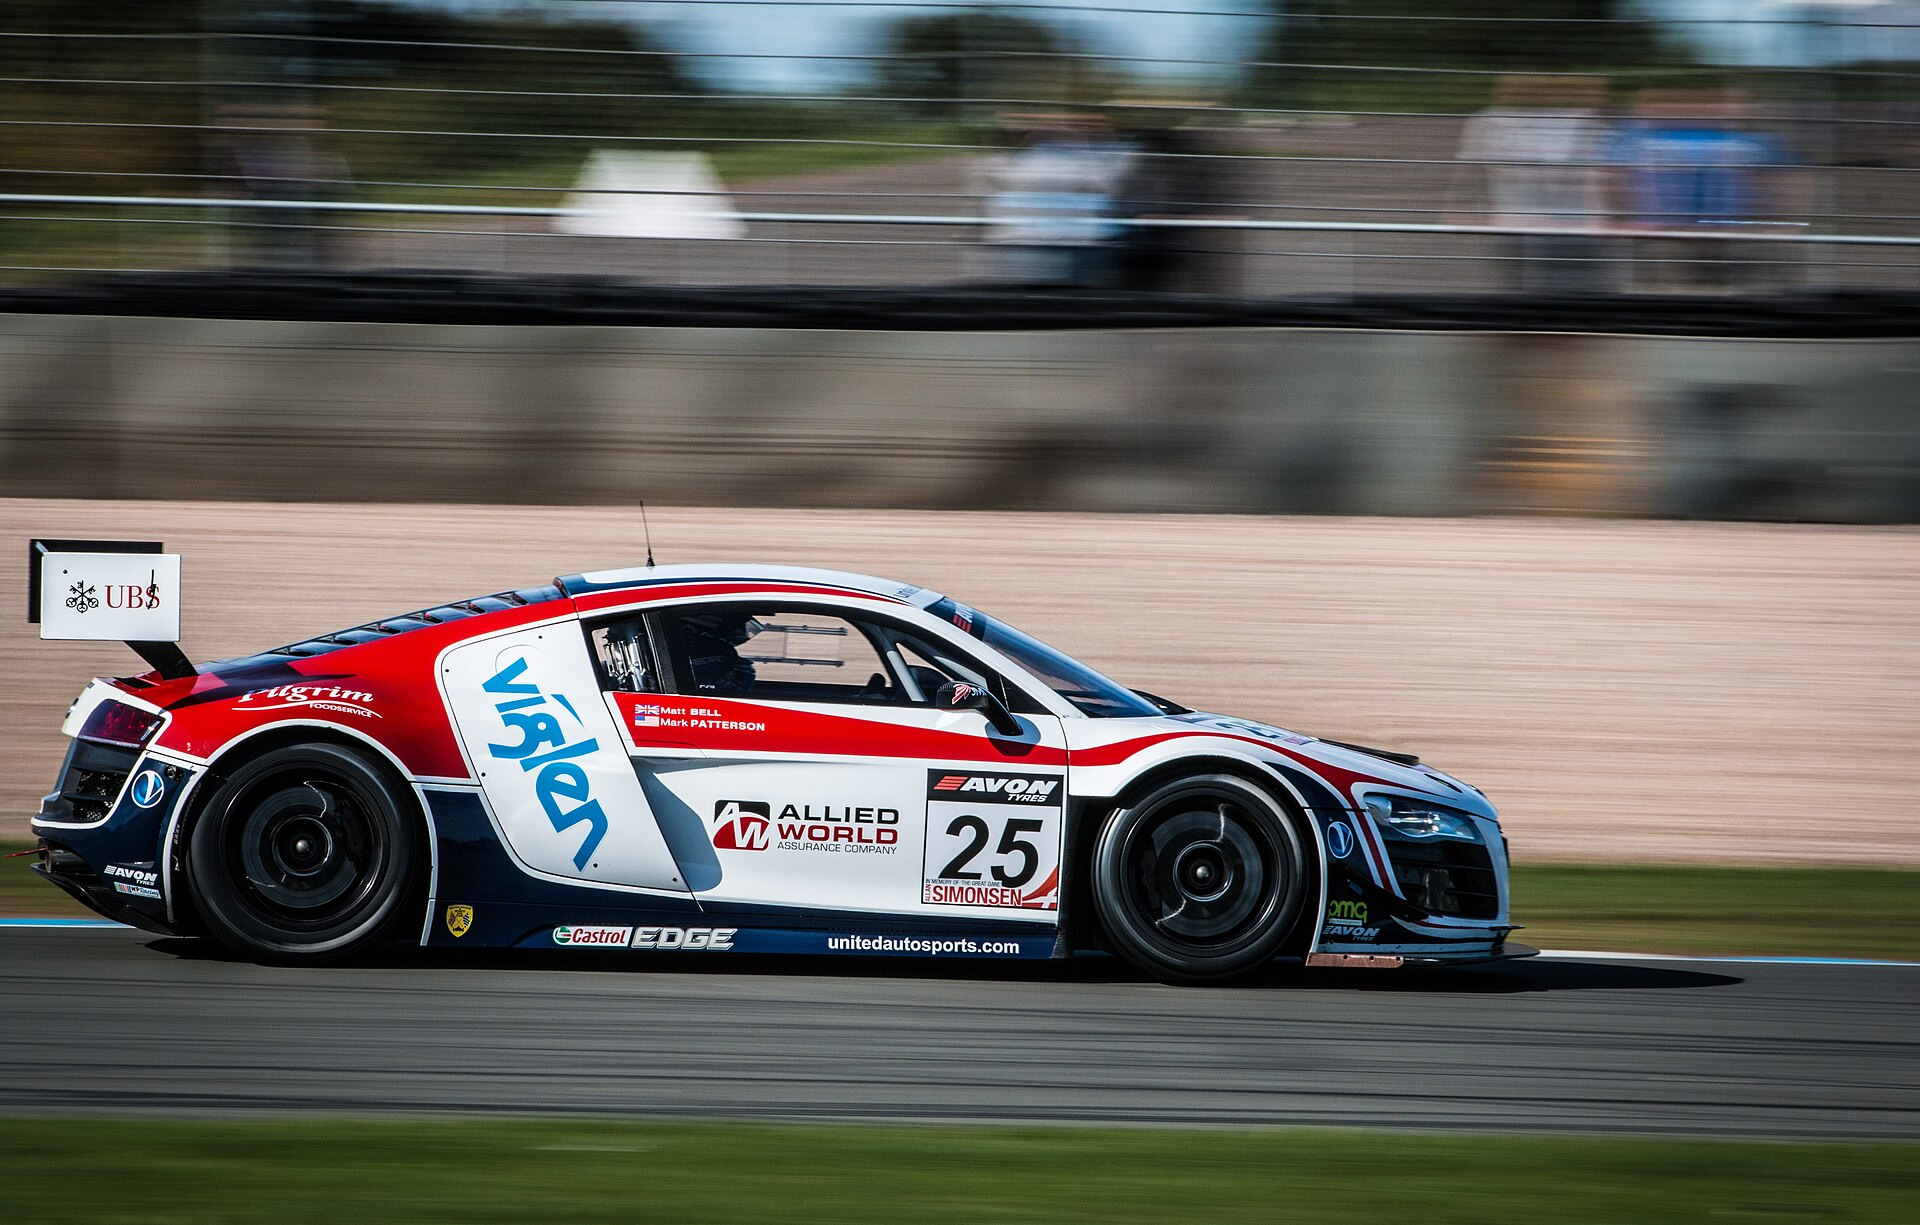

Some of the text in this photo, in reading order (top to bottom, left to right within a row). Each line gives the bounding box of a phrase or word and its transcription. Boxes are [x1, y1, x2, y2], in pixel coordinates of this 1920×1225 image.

[105, 584, 160, 609] UBS
[238, 685, 374, 702] Pilgrim
[309, 702, 372, 718] FOODSERVICE
[660, 707, 721, 717] Matt BELL
[660, 718, 765, 731] Mark PATTERSON
[960, 777, 1058, 794] AVON
[1007, 793, 1048, 802] TYRES
[778, 804, 899, 825] ALLIED
[778, 823, 898, 845] WORLD
[777, 842, 897, 855] ASSURANCE COMPANY
[938, 815, 1043, 888] 25
[115, 868, 158, 881] AVON
[932, 885, 1022, 905] SIMONSEN
[572, 928, 627, 944] Castrol
[631, 927, 738, 950] EDGE
[1330, 927, 1381, 937] AVON
[828, 935, 1020, 955] unitedautosports.com
